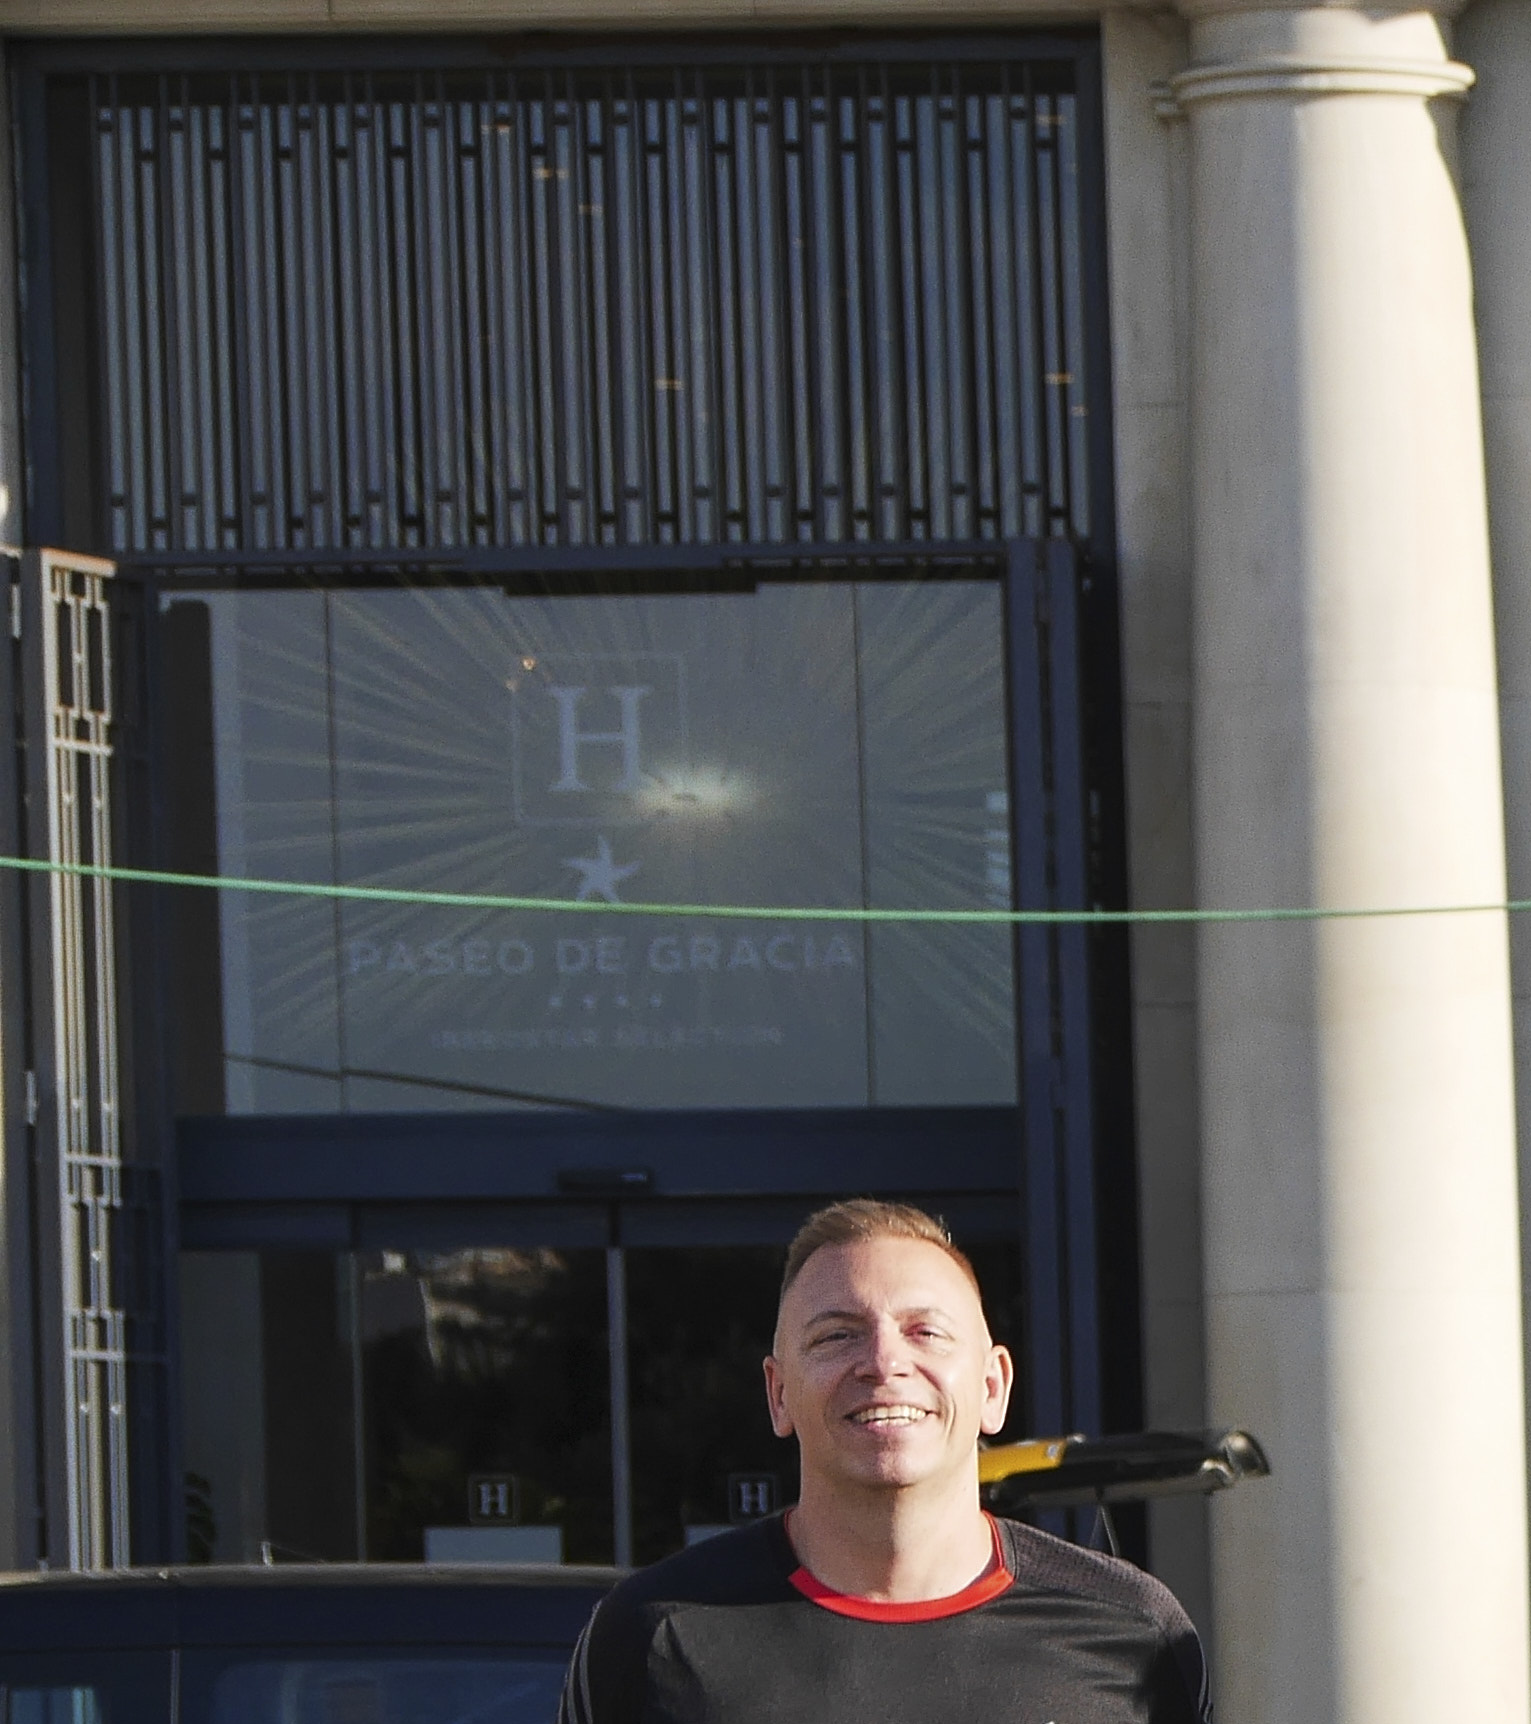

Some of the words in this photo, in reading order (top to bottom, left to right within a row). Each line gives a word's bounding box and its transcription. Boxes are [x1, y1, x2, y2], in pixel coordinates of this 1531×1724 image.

[547, 686, 651, 792] H
[347, 937, 534, 976] PASEO
[555, 936, 627, 975] DE
